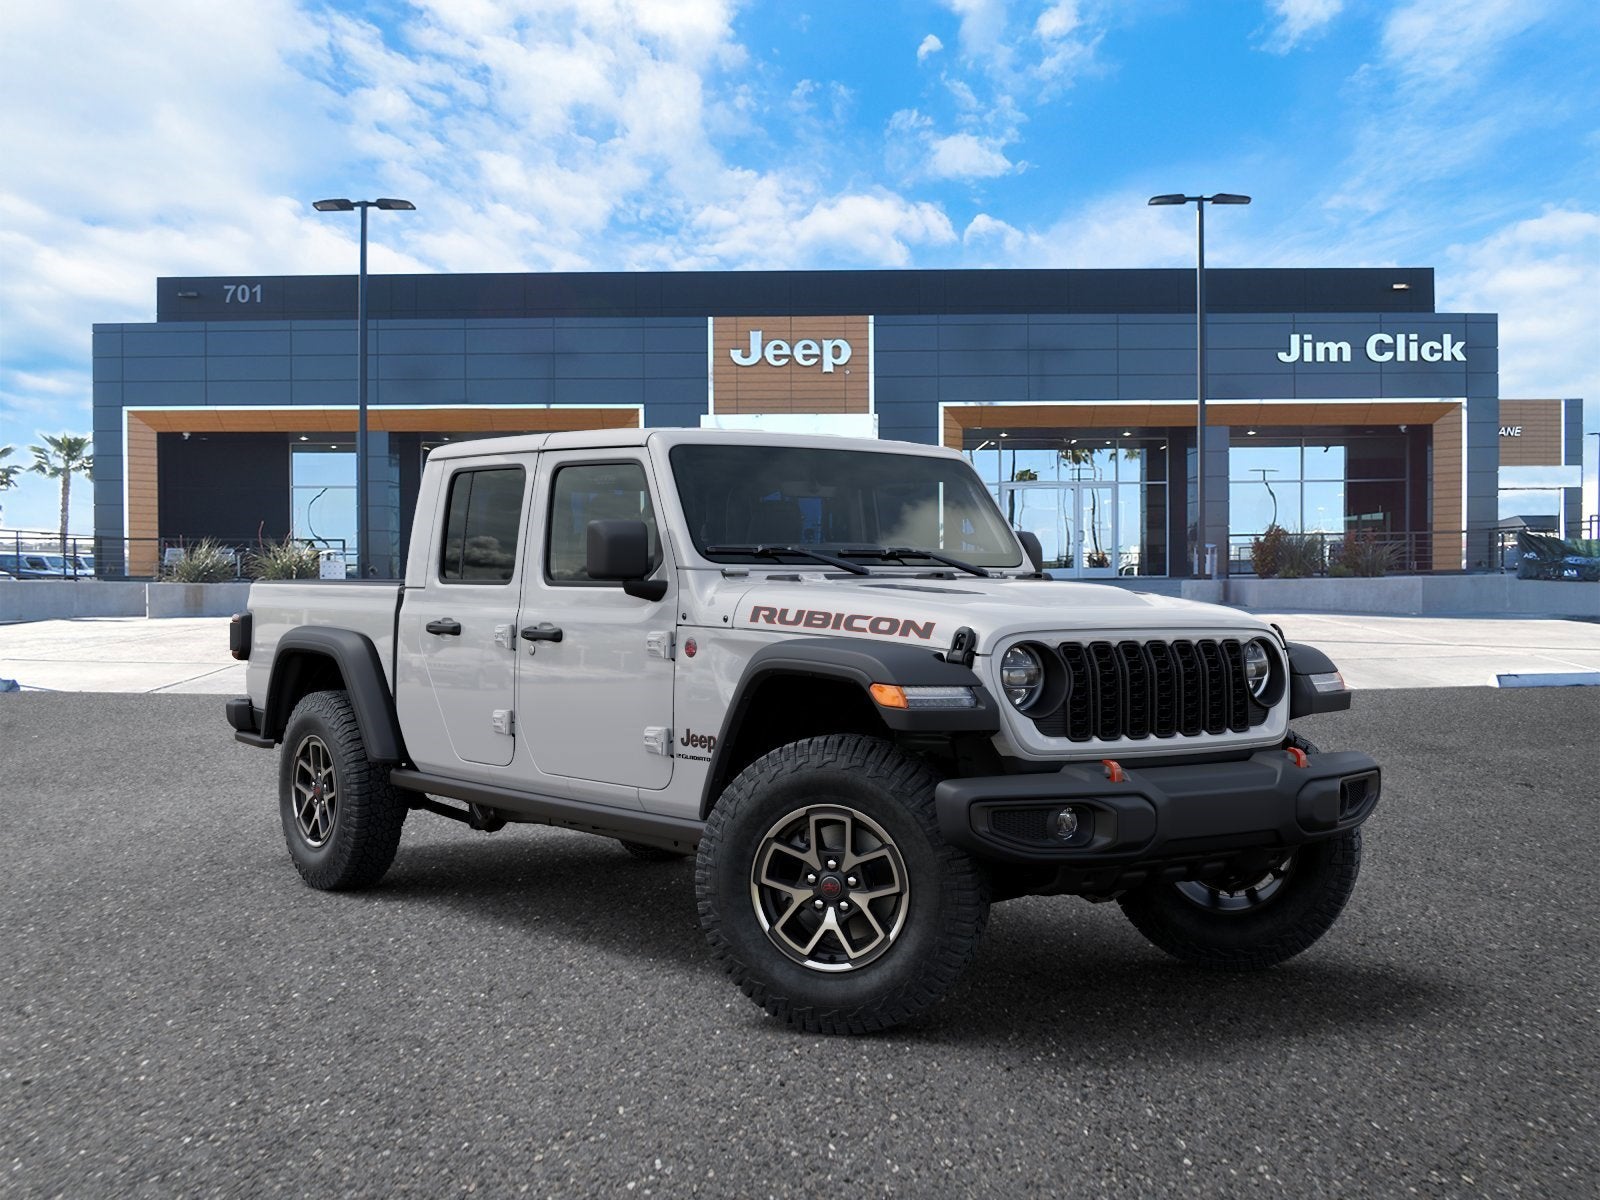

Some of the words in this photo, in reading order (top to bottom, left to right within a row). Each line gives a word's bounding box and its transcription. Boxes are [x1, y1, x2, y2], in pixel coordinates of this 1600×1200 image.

[223, 284, 261, 303] 701
[729, 330, 852, 373] Jeep
[1277, 333, 1351, 363] Jim
[1366, 333, 1467, 363] Click
[1498, 426, 1522, 437] ANE
[750, 605, 936, 640] RUBICON
[680, 728, 717, 753] Jeep
[682, 753, 711, 762] GLADIATO
